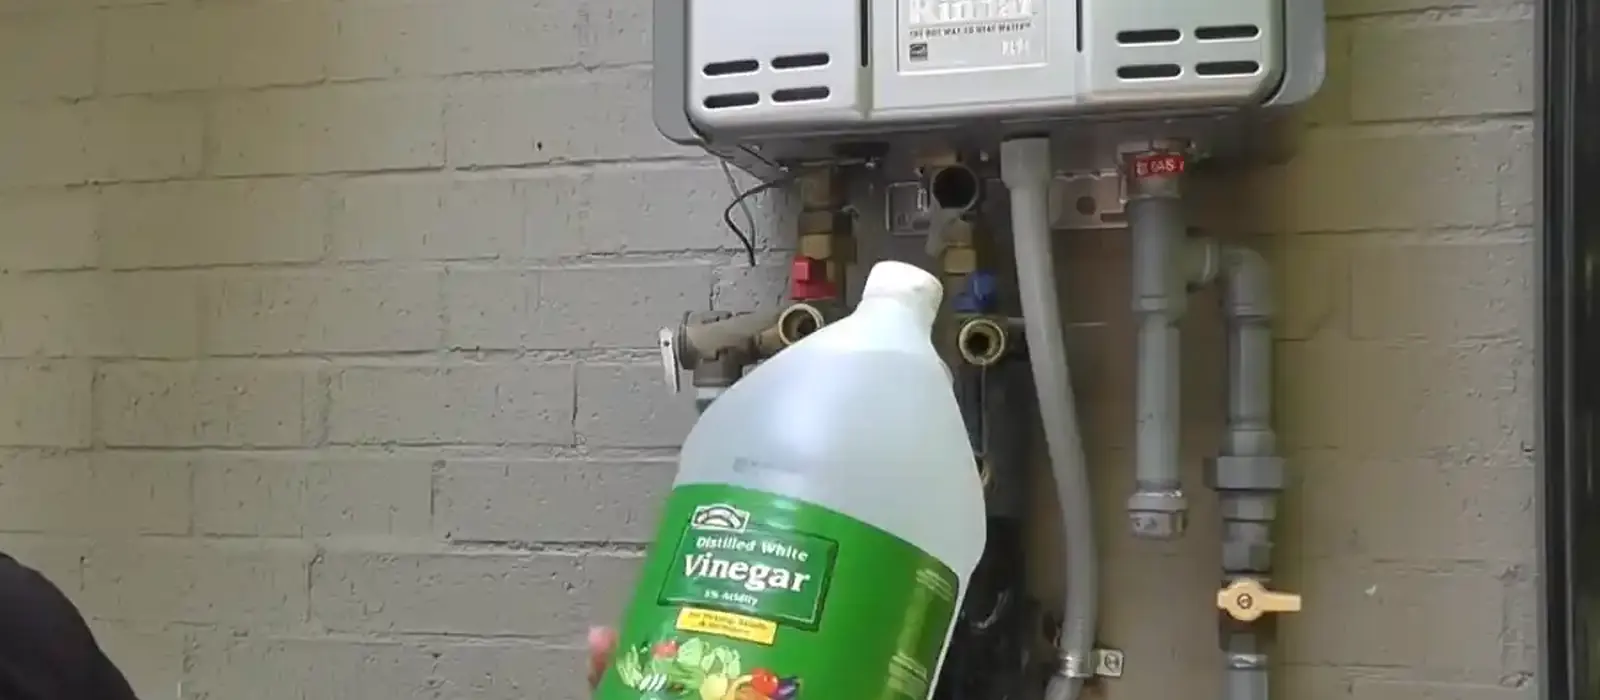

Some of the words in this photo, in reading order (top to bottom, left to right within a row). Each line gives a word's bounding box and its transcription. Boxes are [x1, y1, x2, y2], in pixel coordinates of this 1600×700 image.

[696, 536, 757, 552] Distilled
[761, 541, 809, 562] White
[684, 551, 811, 592] Vinegar
